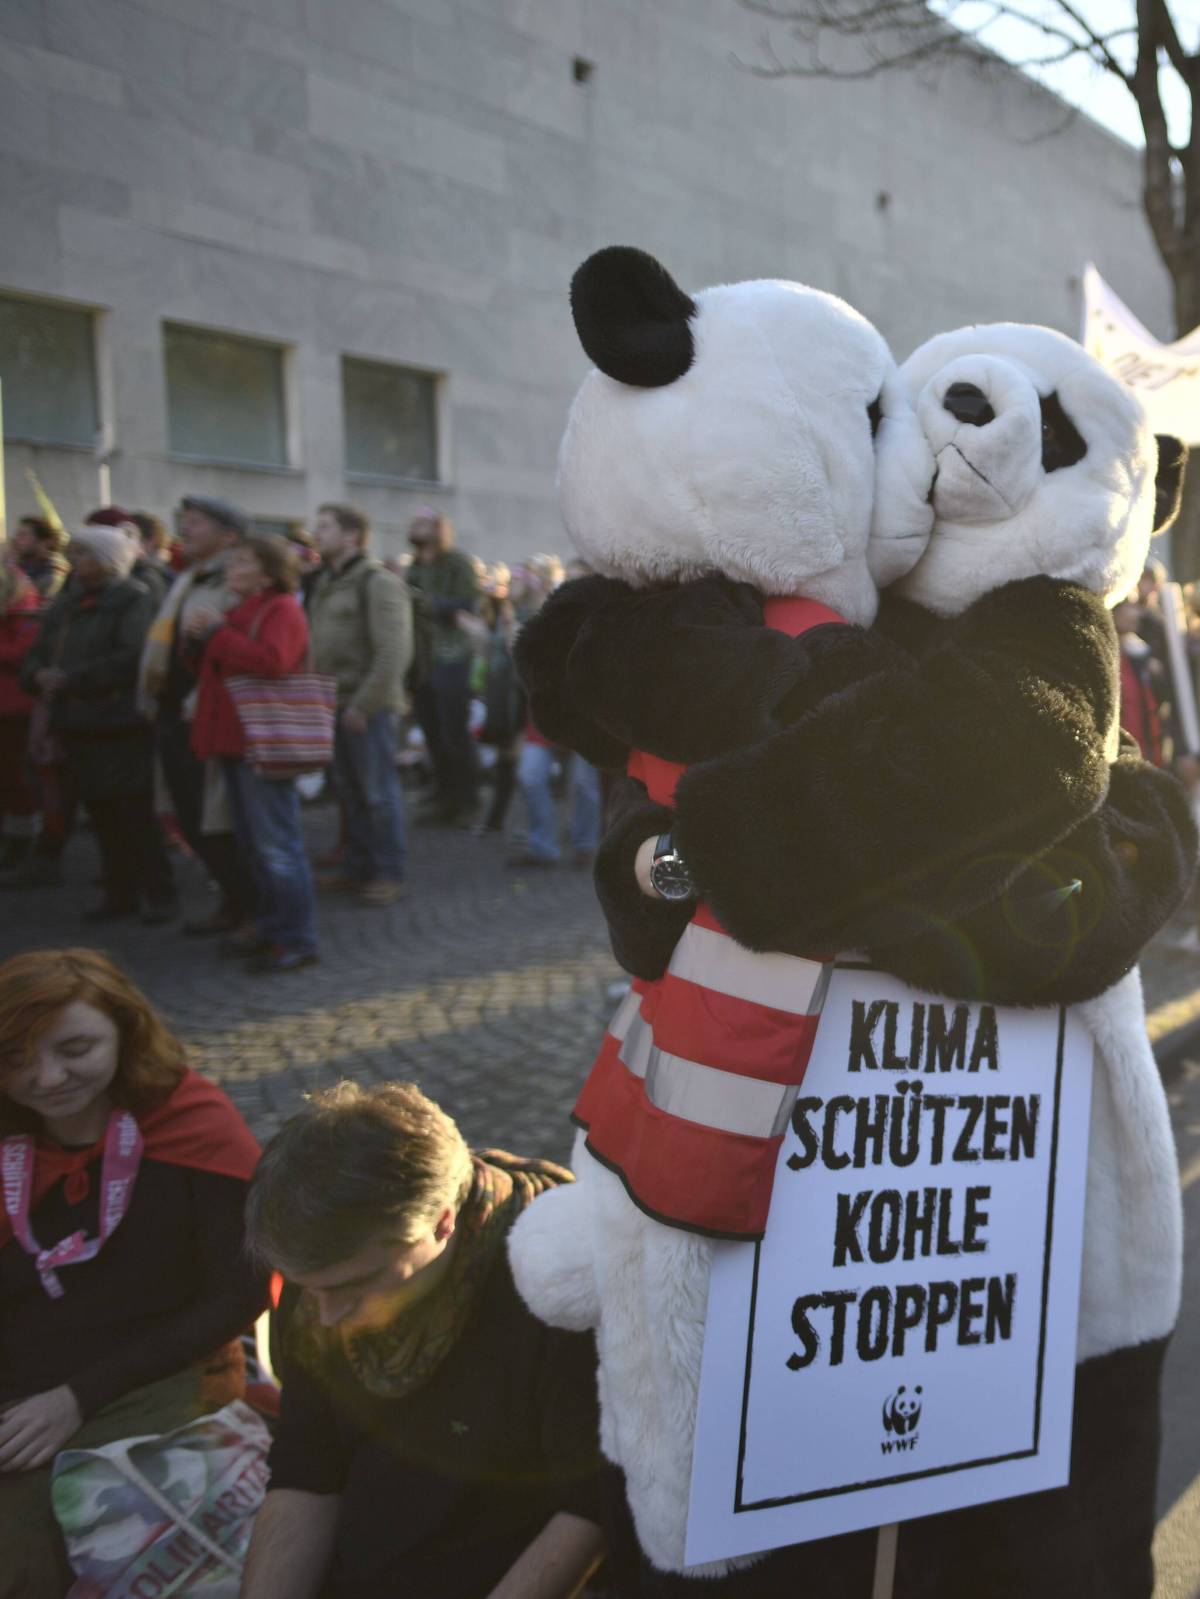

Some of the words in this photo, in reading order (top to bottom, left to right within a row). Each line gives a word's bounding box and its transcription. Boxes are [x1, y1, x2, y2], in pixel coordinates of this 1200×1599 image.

[847, 999, 999, 1074] KLIMA
[786, 1079, 1041, 1171] SCHÜTZEN
[832, 1185, 992, 1268] KOHLE
[785, 1272, 1018, 1372] STOPPEN
[881, 1433, 919, 1455] WWF
